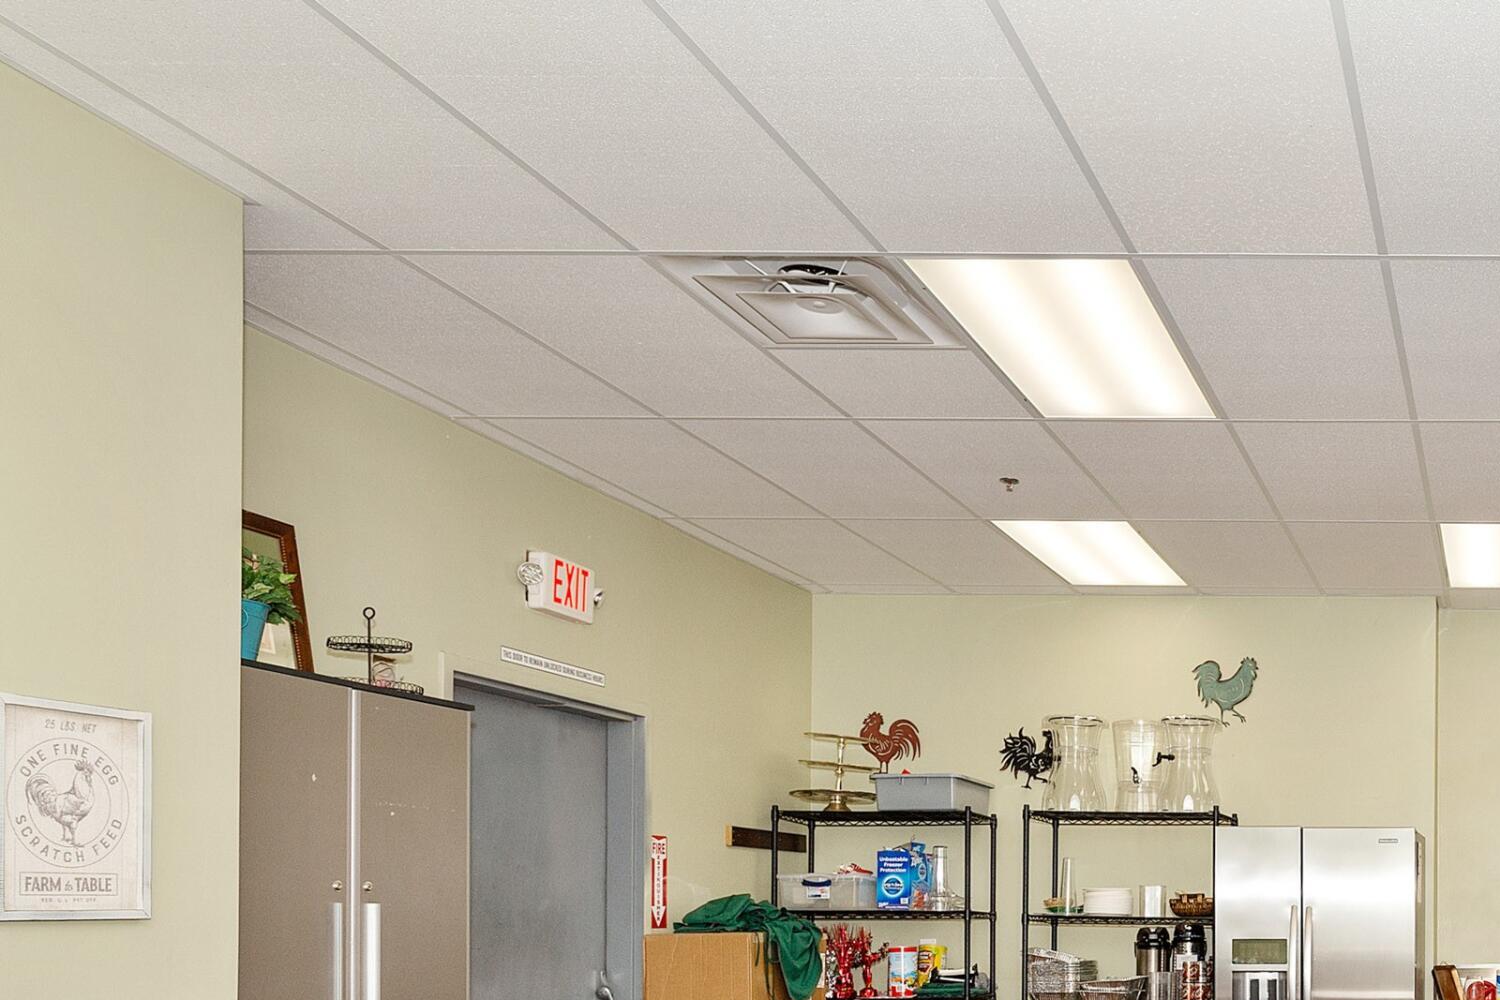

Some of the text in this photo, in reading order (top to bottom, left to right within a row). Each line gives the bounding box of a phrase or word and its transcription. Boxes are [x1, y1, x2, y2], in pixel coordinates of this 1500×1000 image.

[553, 559, 589, 612] EXIT
[45, 719, 55, 729] 25
[82, 723, 97, 734] NET
[20, 743, 119, 786] ONE FINE EGG
[15, 814, 122, 863] SCRATCH FEED
[652, 842, 666, 855] FIRE
[25, 876, 61, 892] FARM
[74, 877, 112, 892] TABLE
